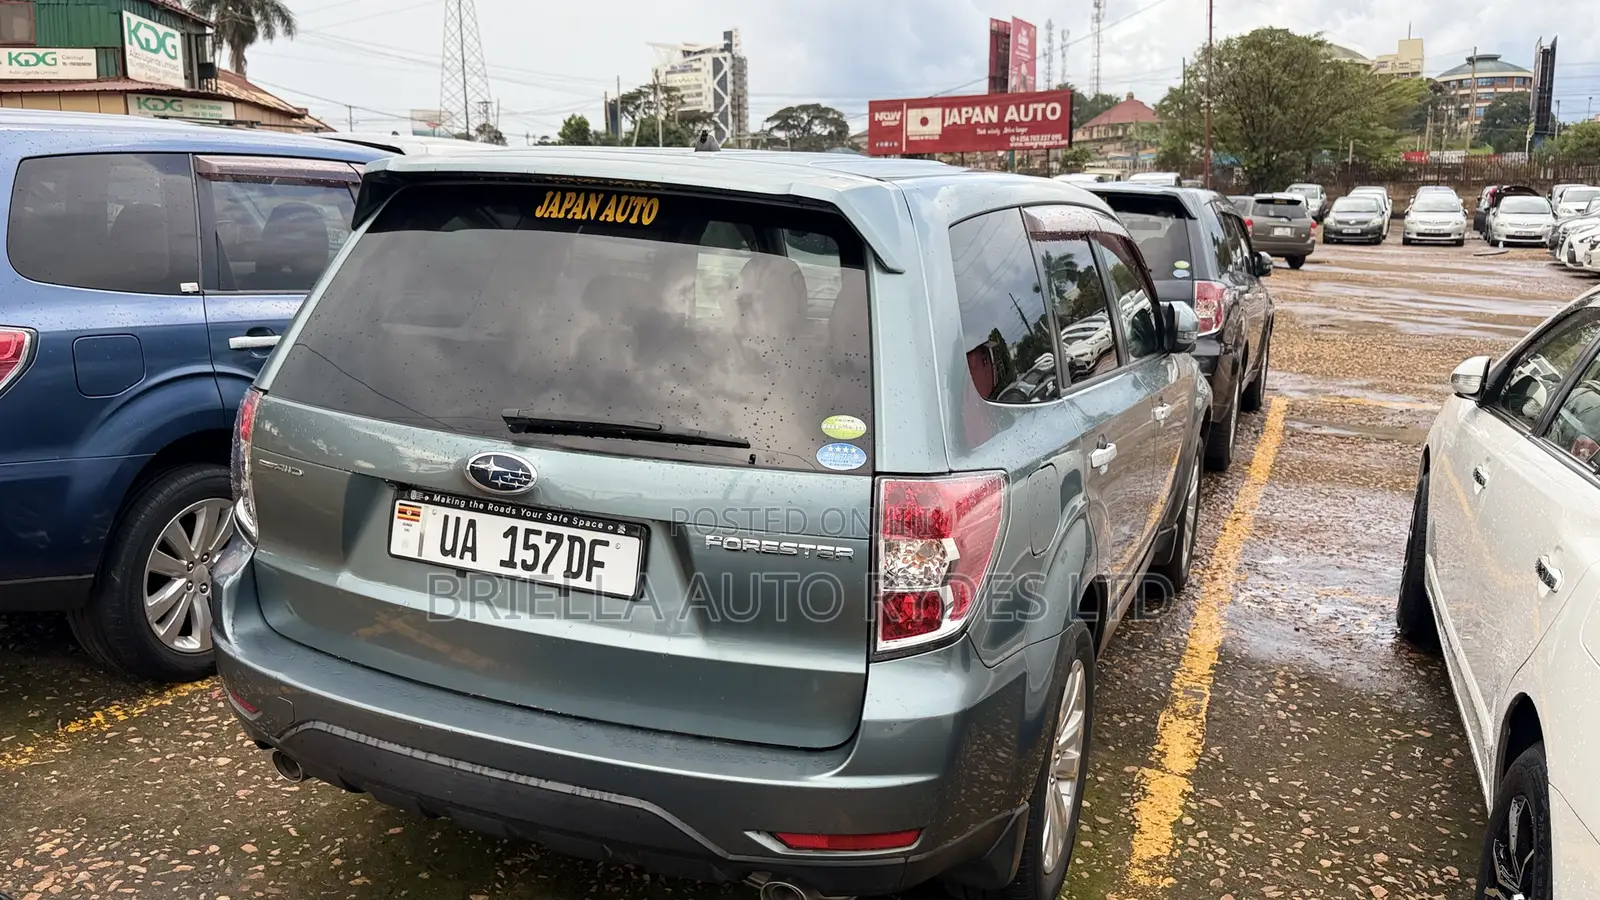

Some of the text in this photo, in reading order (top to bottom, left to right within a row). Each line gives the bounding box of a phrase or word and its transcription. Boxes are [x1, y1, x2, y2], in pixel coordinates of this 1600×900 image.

[126, 16, 178, 60] KDG
[8, 51, 57, 67] KDG
[136, 96, 184, 112] KDG
[943, 102, 1061, 127] JAPAN AUTO
[535, 191, 659, 225] JAPAN AUTO
[433, 494, 604, 529] Making the Roads Your Safe Space
[439, 514, 610, 582] UA 157DF
[705, 534, 855, 561] FORESTER
